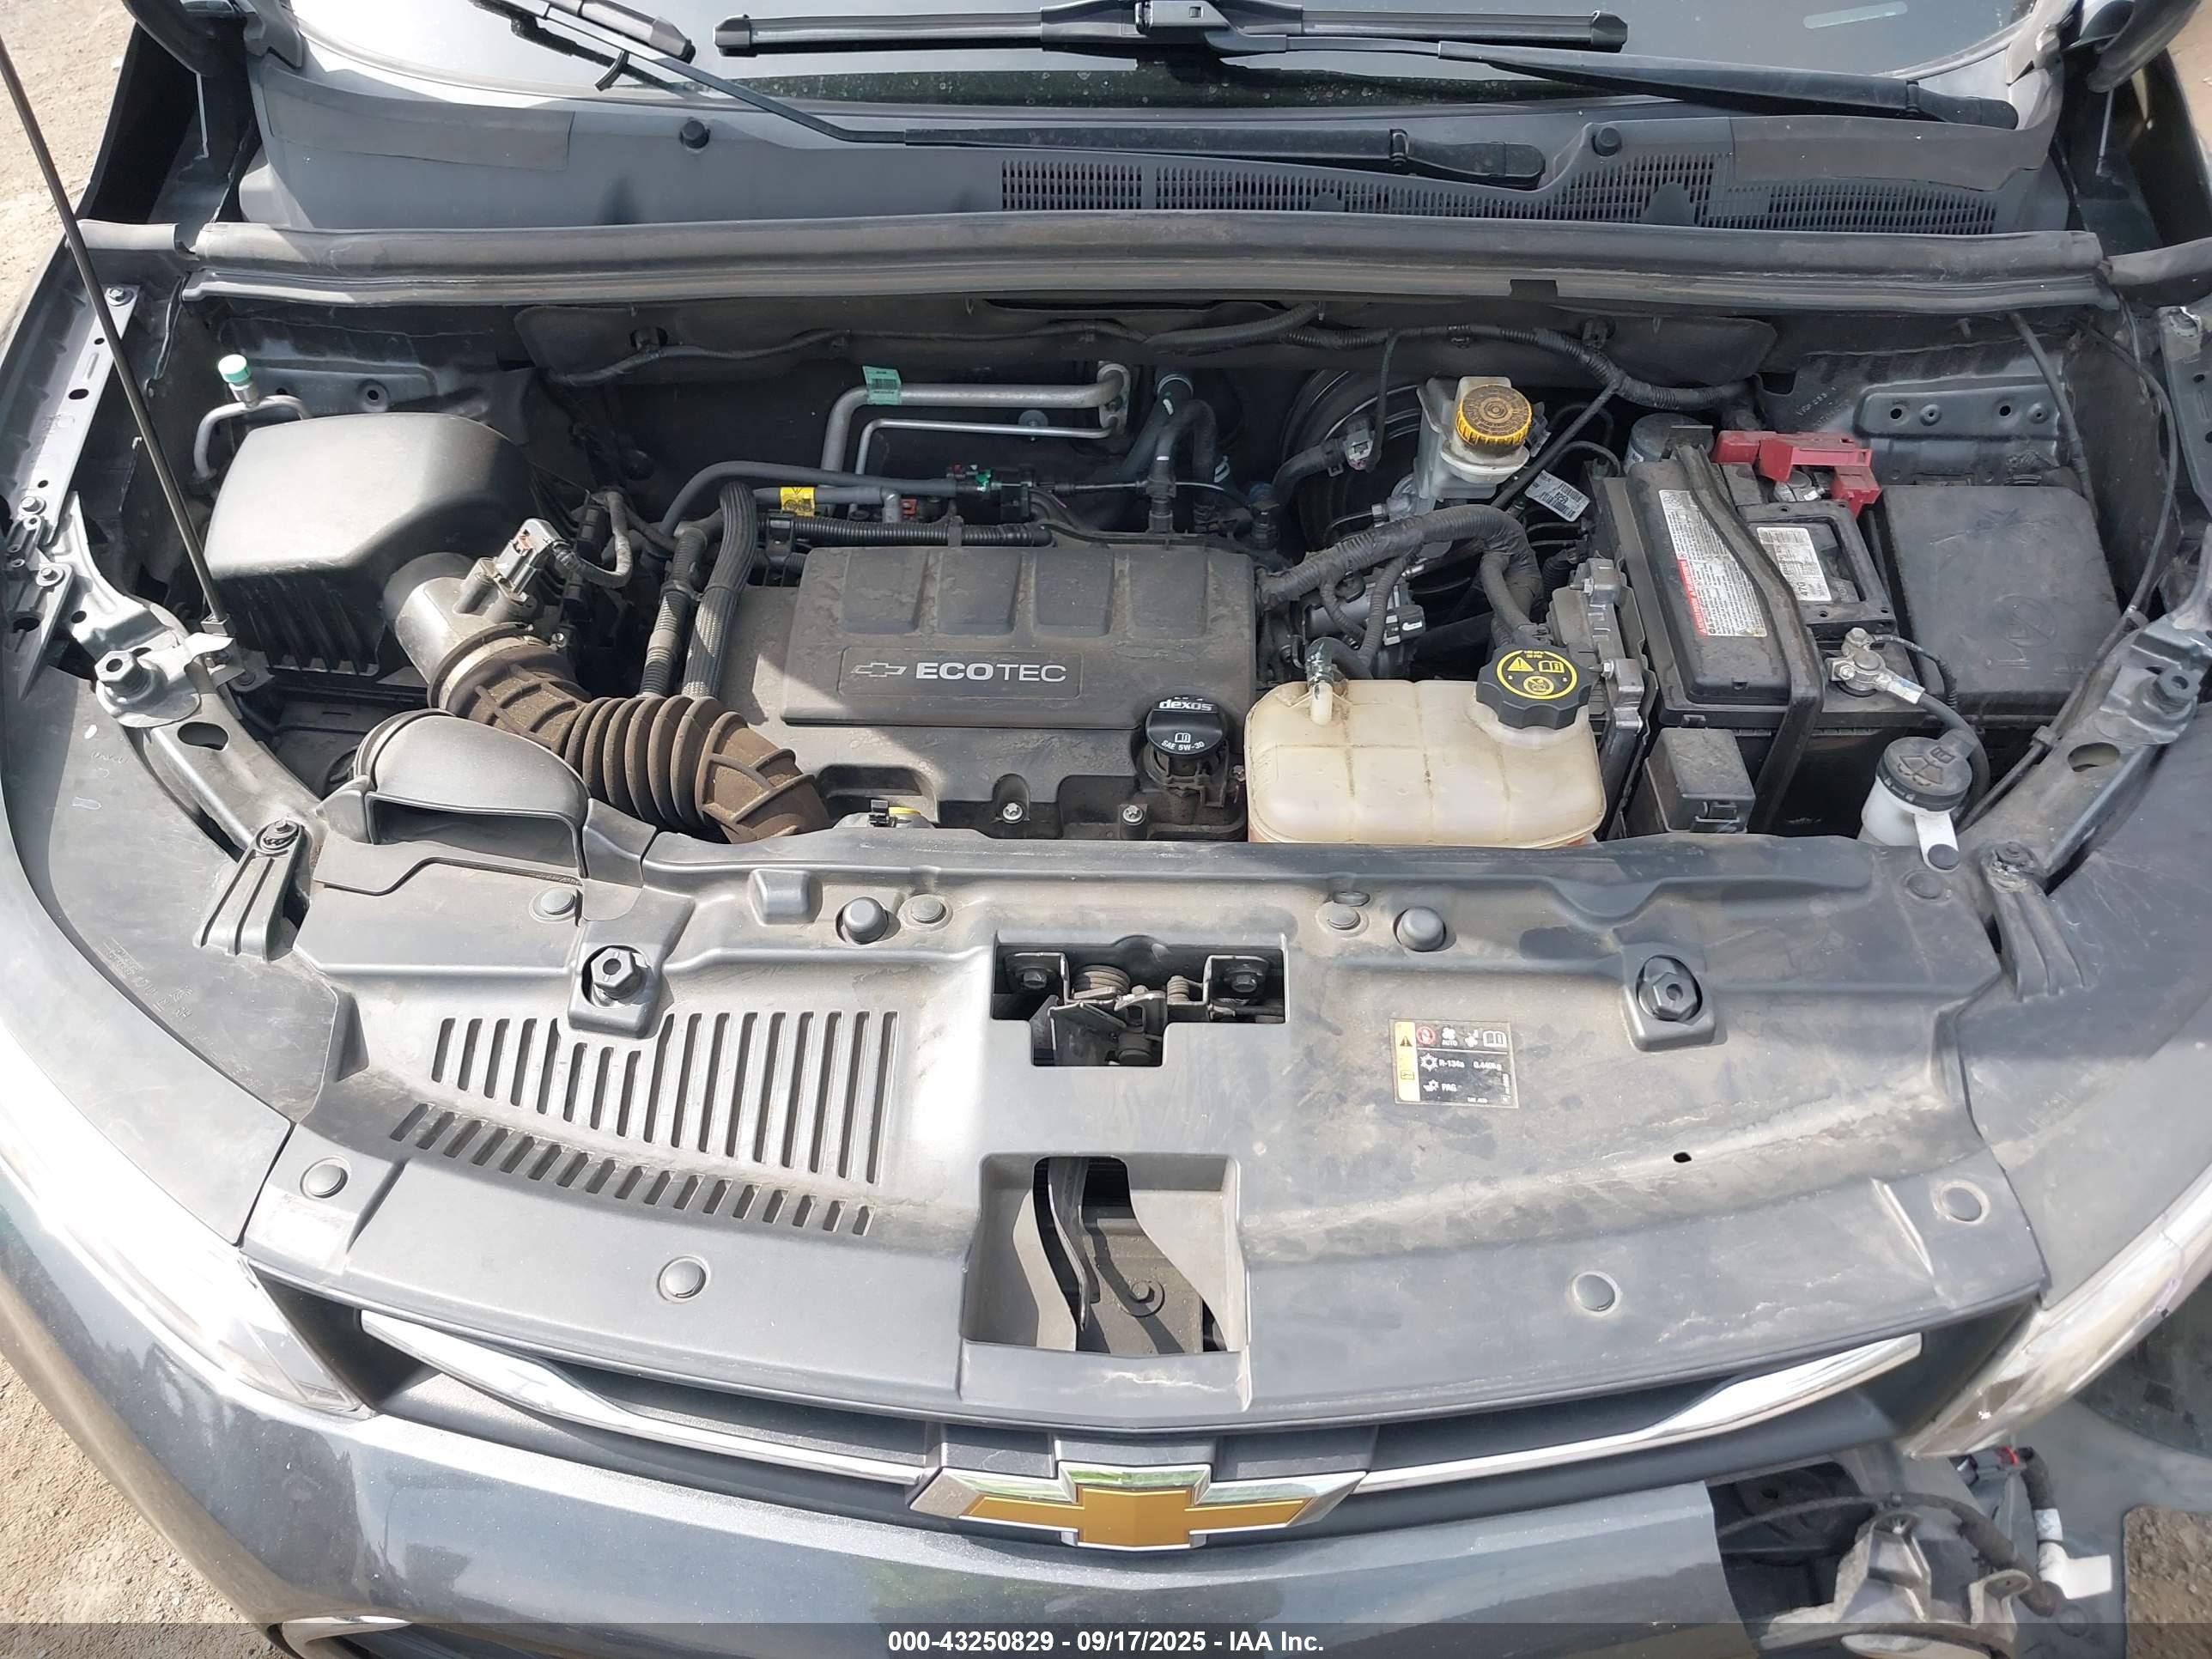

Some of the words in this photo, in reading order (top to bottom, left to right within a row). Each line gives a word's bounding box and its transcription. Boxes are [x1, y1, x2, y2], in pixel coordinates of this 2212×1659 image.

[915, 662, 1066, 683] ECOTEC
[1158, 699, 1214, 712] dexos
[1161, 739, 1176, 750] SAE
[1178, 740, 1206, 751] 5W-30
